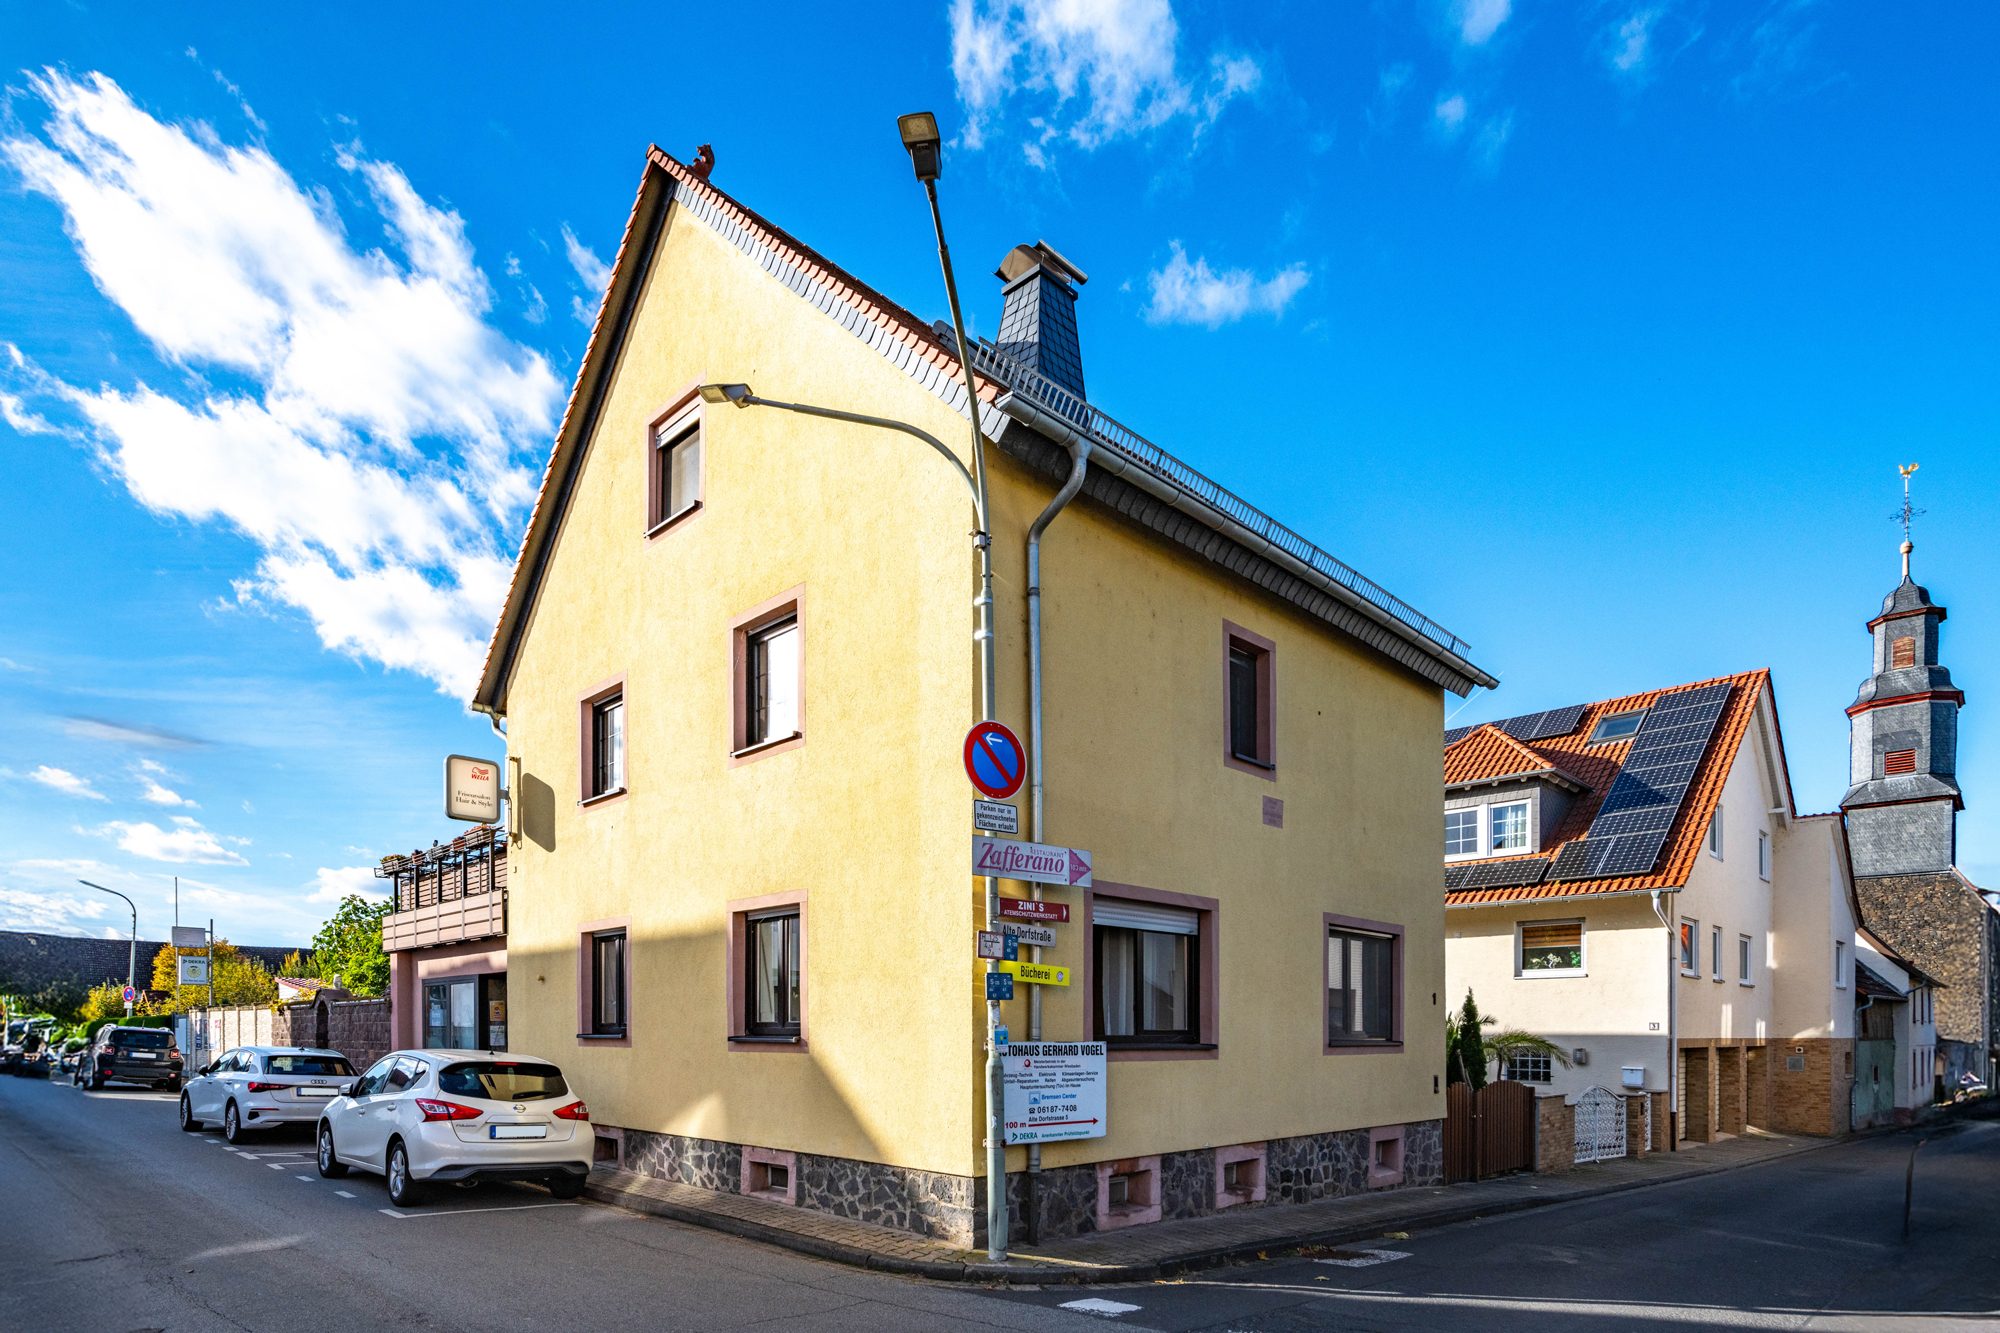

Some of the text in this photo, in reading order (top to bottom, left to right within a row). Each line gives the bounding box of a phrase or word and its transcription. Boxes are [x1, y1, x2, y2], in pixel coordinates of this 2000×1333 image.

[471, 773, 489, 781] WELLA
[980, 803, 996, 812] Parken
[976, 812, 1015, 822] gekennzeichneten
[979, 819, 997, 828] Flächen
[977, 842, 1065, 873] Zafferano
[1030, 847, 1064, 859] RESTAURANT
[1004, 910, 1058, 919] ATEMSCHUTZWERKSTATT
[1002, 924, 1051, 942] Alte Dorfstraße
[1020, 966, 1050, 980] Bücherei
[999, 1045, 1040, 1056] TOHAUS
[1042, 1045, 1078, 1056] GERHARD
[1081, 1045, 1104, 1055] VOGEL
[1037, 1104, 1077, 1113] 06187-7408
[1005, 1121, 1018, 1129] 100
[1019, 1132, 1038, 1140] DEKRA
